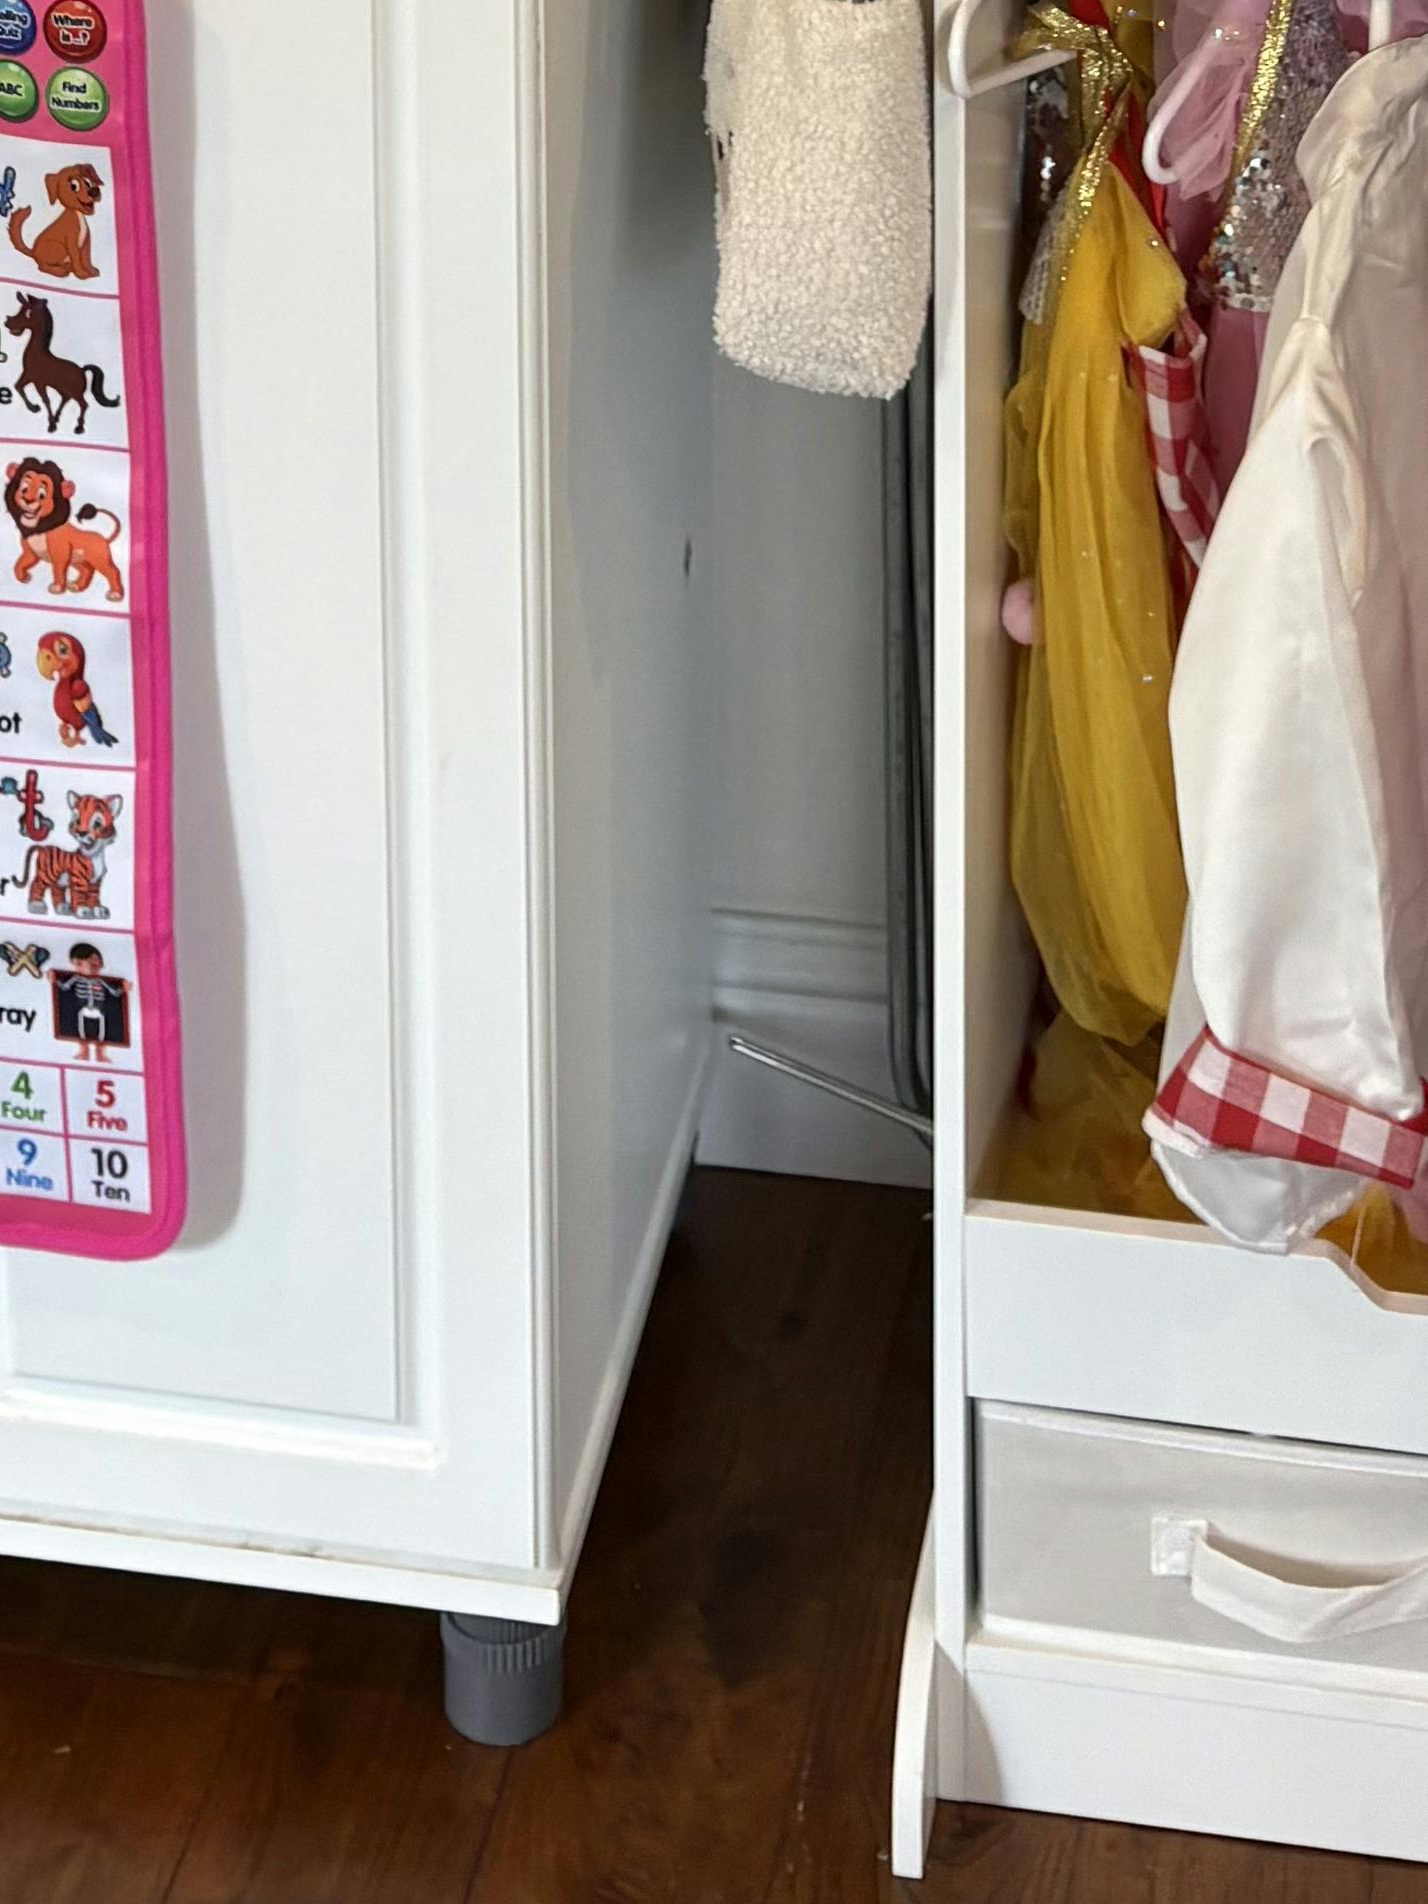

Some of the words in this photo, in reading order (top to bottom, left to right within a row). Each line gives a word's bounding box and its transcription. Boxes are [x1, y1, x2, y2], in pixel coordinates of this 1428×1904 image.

[52, 13, 93, 31] Where
[61, 79, 88, 96] Find
[50, 96, 101, 113] Numbers
[10, 1071, 34, 1100] 4
[95, 1080, 116, 1108] 5
[0, 1100, 47, 1124] Four
[85, 1109, 128, 1133] Five
[16, 1138, 38, 1166] 9
[91, 1148, 129, 1179] 10
[5, 1168, 54, 1192] Nine
[91, 1180, 131, 1202] Ten
